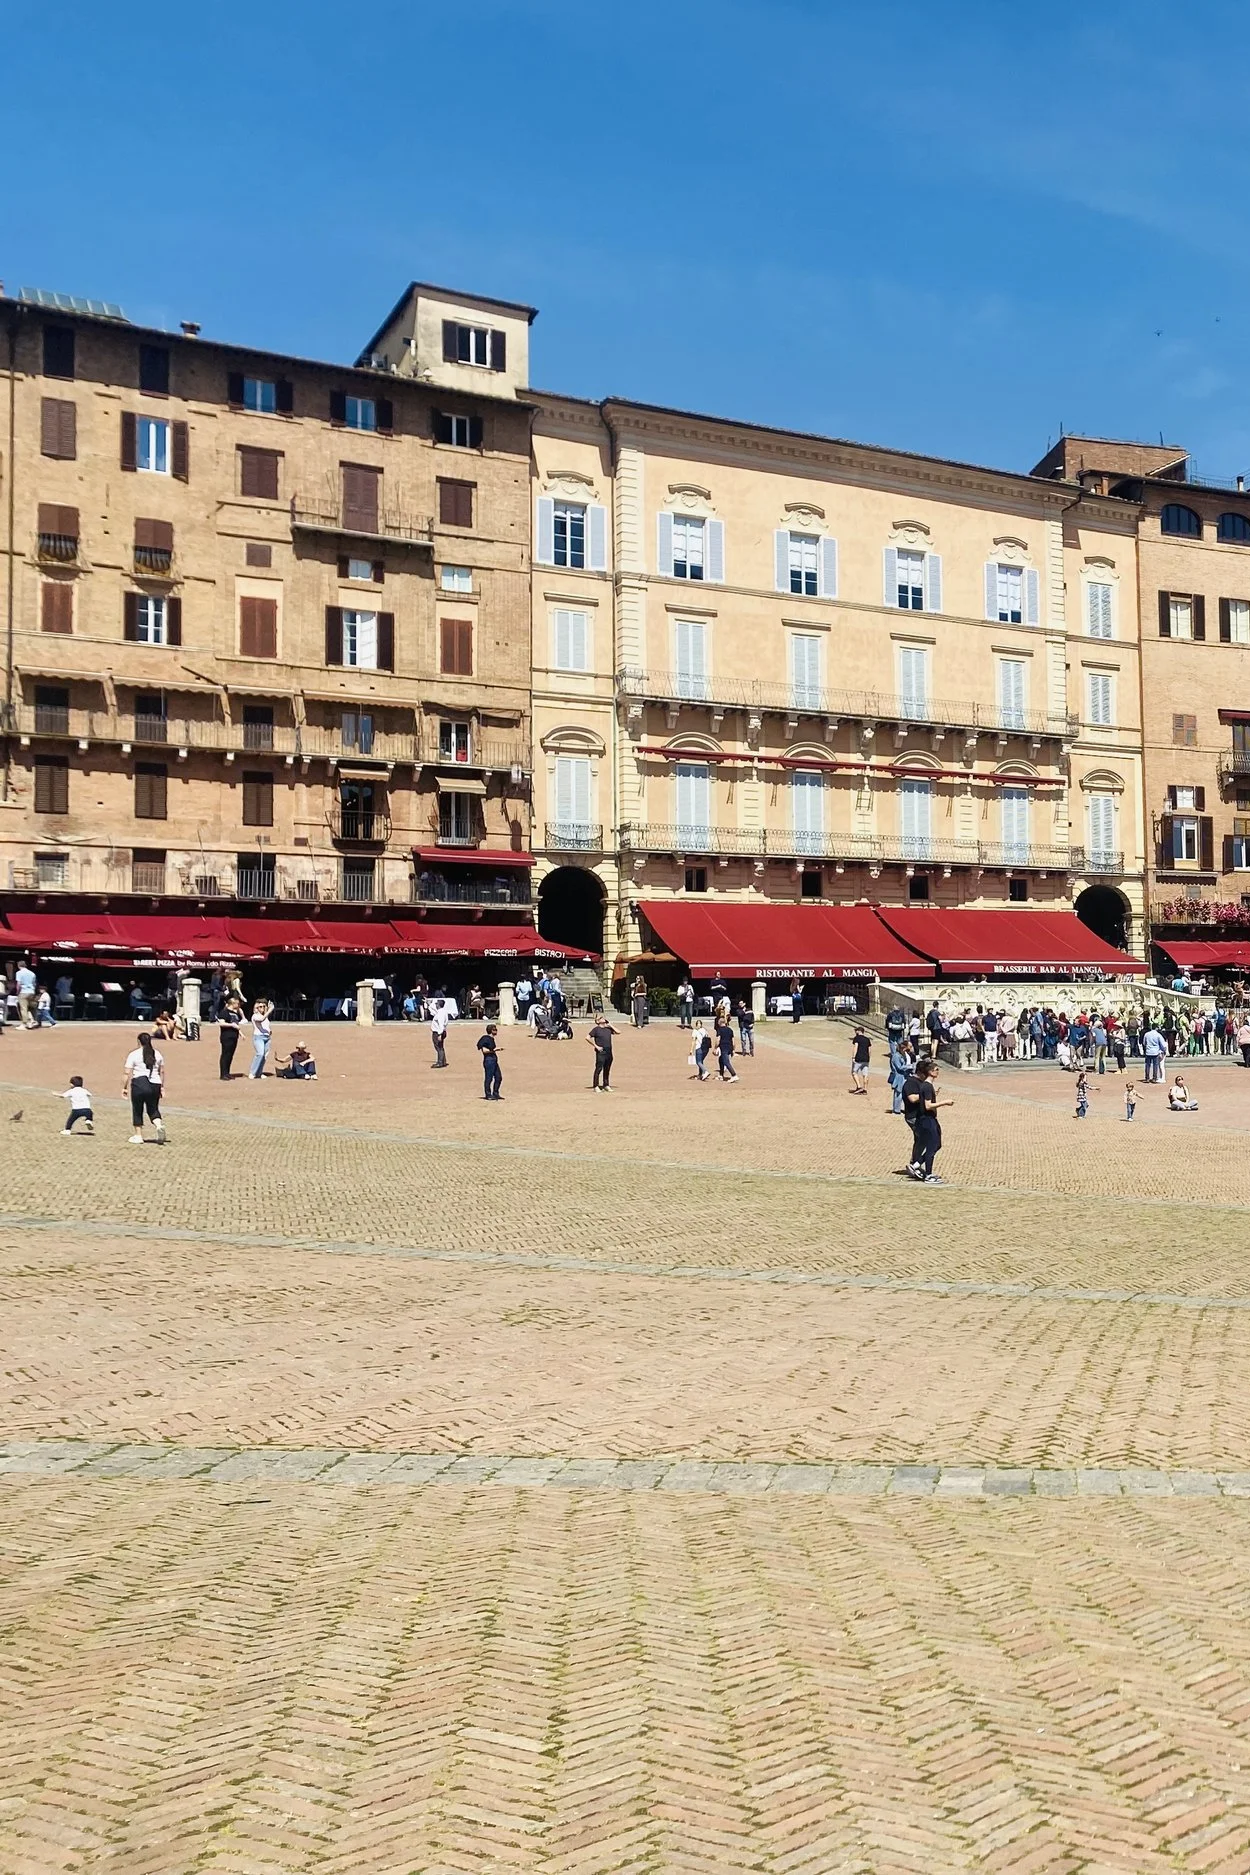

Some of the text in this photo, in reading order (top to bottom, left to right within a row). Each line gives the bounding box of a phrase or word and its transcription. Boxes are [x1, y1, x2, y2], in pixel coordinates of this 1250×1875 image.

[483, 948, 518, 957] PIZZERIA
[534, 947, 566, 959] BISTROT
[177, 960, 186, 968] by
[756, 968, 879, 978] RISTORANTE AL MANGIA
[993, 965, 1103, 974] BRASSERIE BAR AL MANGIA
